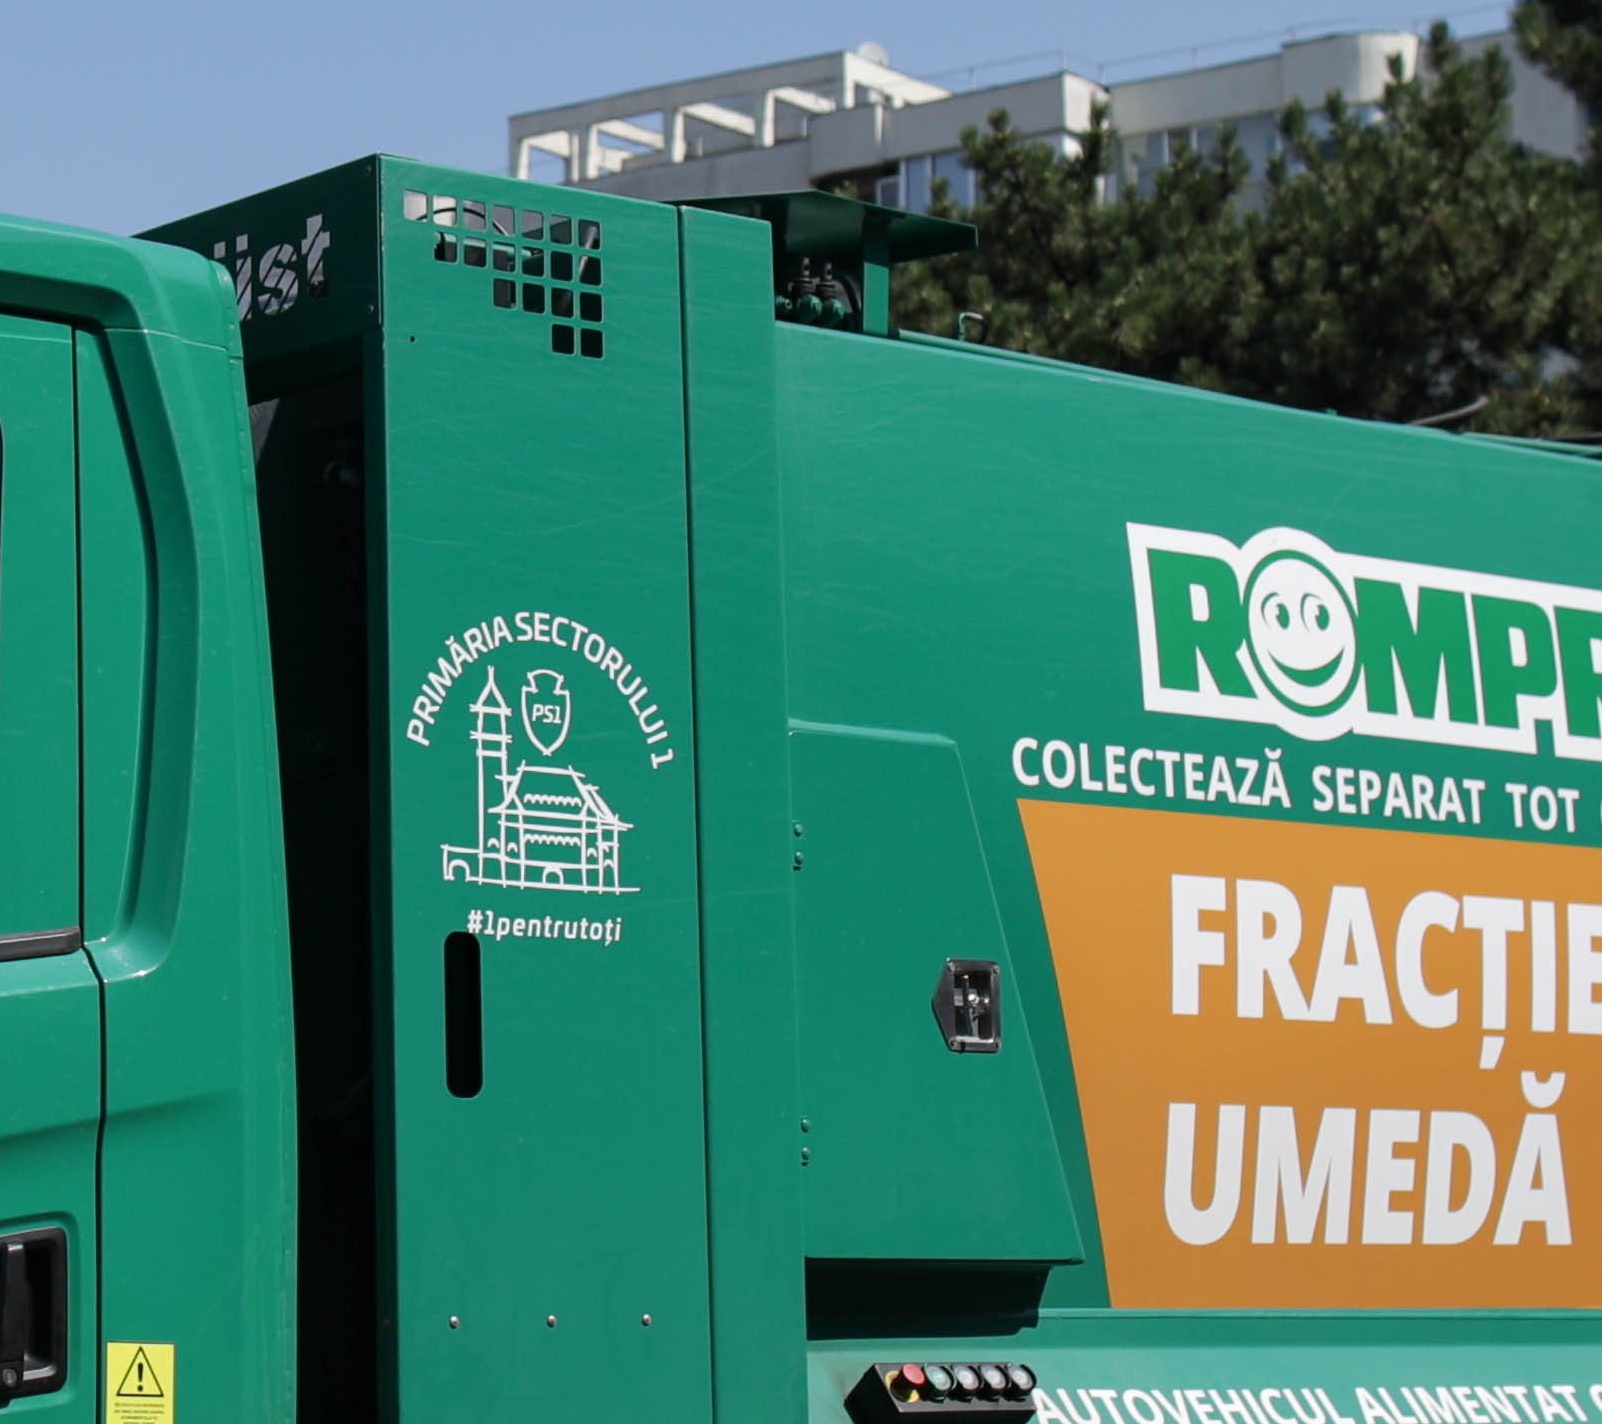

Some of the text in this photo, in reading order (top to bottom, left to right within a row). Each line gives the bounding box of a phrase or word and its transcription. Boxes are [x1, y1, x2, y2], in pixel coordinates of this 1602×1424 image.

[405, 610, 675, 770] PRIMĂRIA SECTORULUI 1
[531, 703, 562, 724] PS1
[1011, 737, 1292, 810] COLECTEAZĂ
[1311, 764, 1486, 825] SEPARAT
[1505, 783, 1581, 834] TOT
[466, 909, 623, 947] #1pentrutoți
[1162, 1070, 1573, 1246] UMEDĂ
